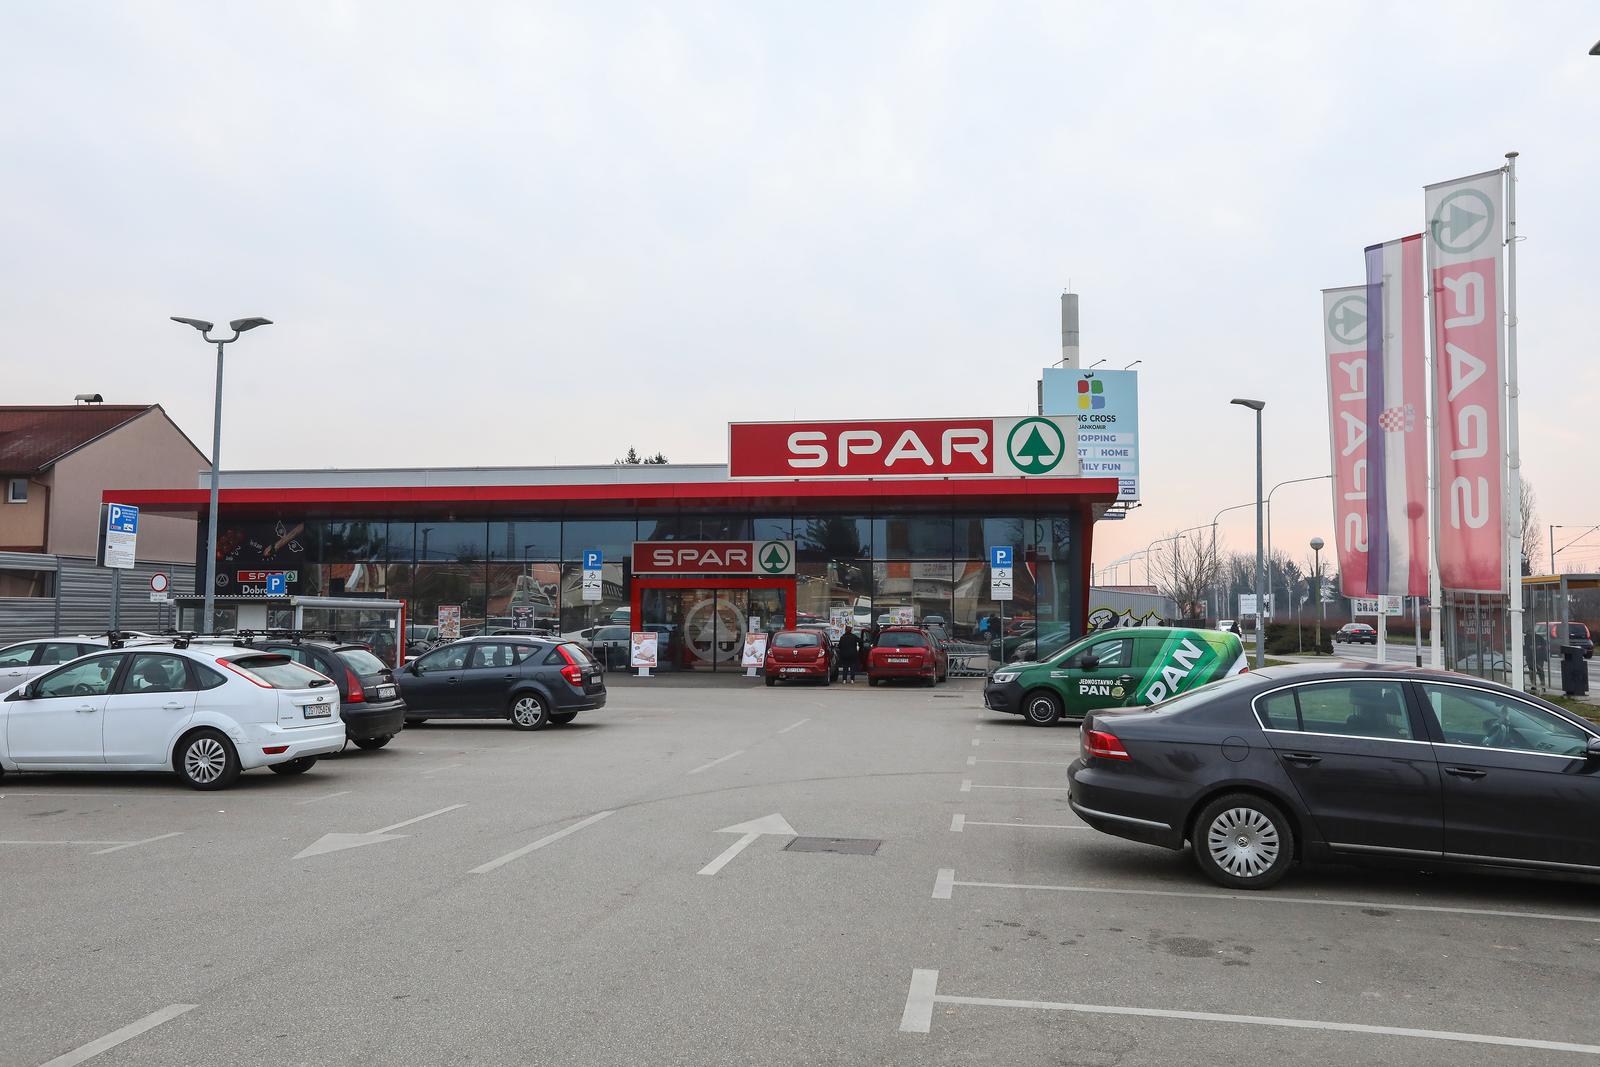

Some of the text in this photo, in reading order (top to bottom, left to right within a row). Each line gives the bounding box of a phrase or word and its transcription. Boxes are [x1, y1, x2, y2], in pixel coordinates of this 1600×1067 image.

[787, 428, 989, 468] SPAR
[112, 506, 121, 524] P
[588, 553, 597, 566] P
[653, 549, 747, 566] SPAR
[996, 550, 1006, 564] P
[271, 578, 280, 590] P
[1145, 638, 1204, 704] PAN
[1078, 678, 1114, 686] JEDNOSTAVNO
[1079, 685, 1110, 696] PAN
